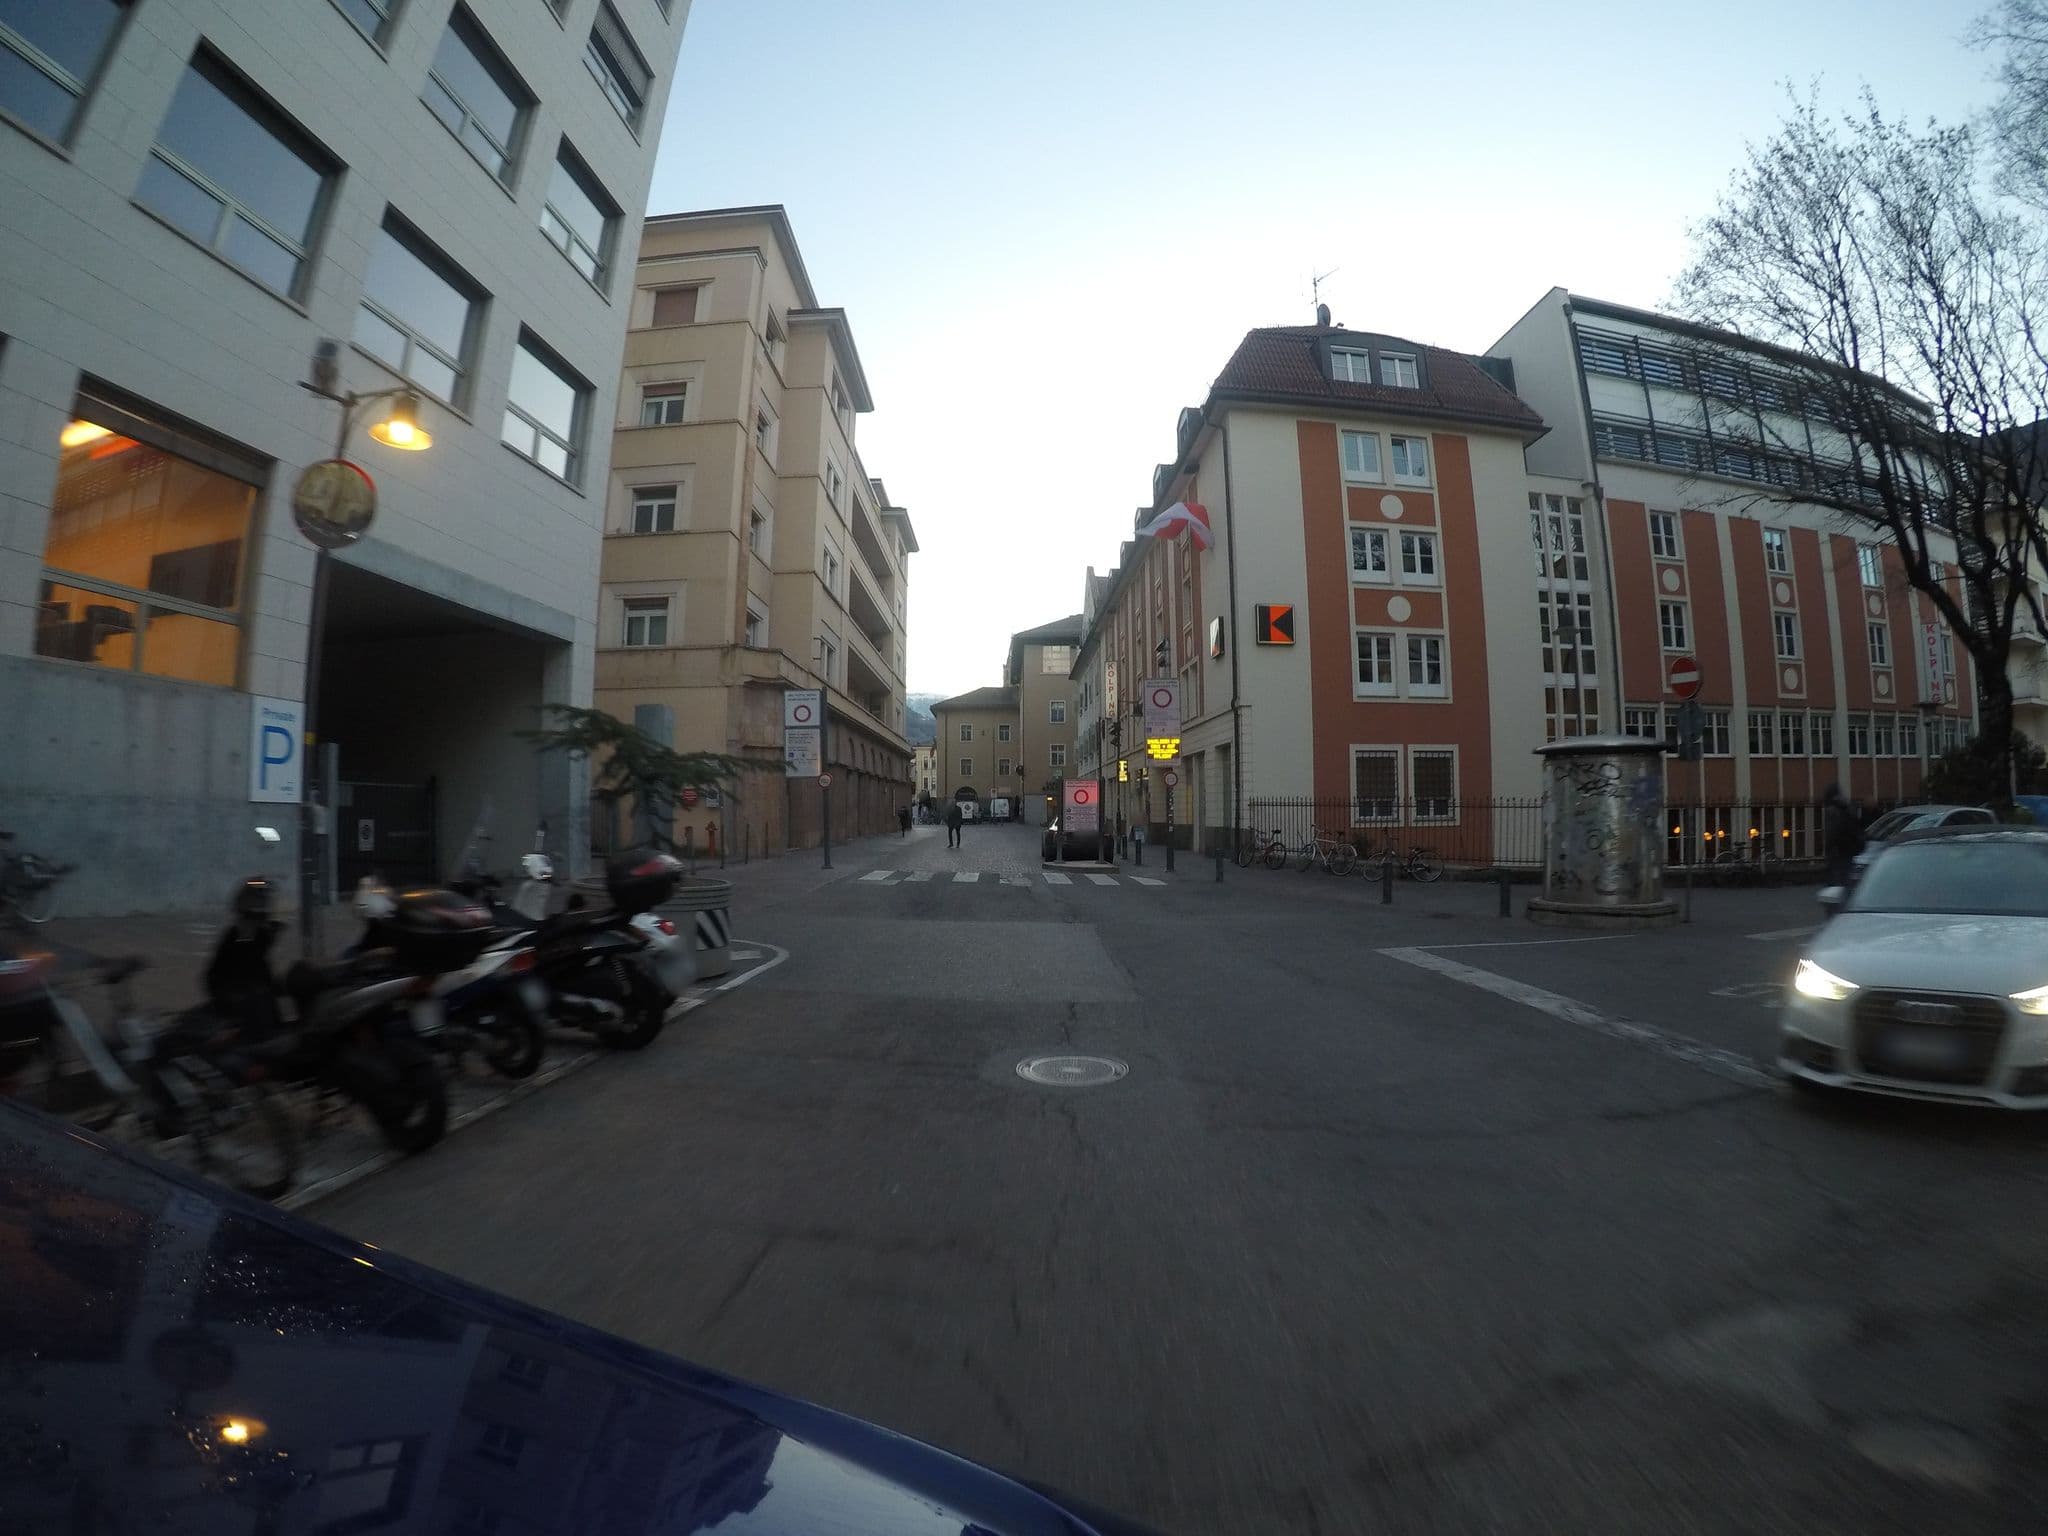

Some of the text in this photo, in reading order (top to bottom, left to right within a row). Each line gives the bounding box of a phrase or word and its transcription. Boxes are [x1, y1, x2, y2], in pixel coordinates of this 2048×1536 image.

[1107, 662, 1115, 718] KOLPING
[1926, 624, 1942, 704] KOLPING
[260, 725, 294, 790] P
